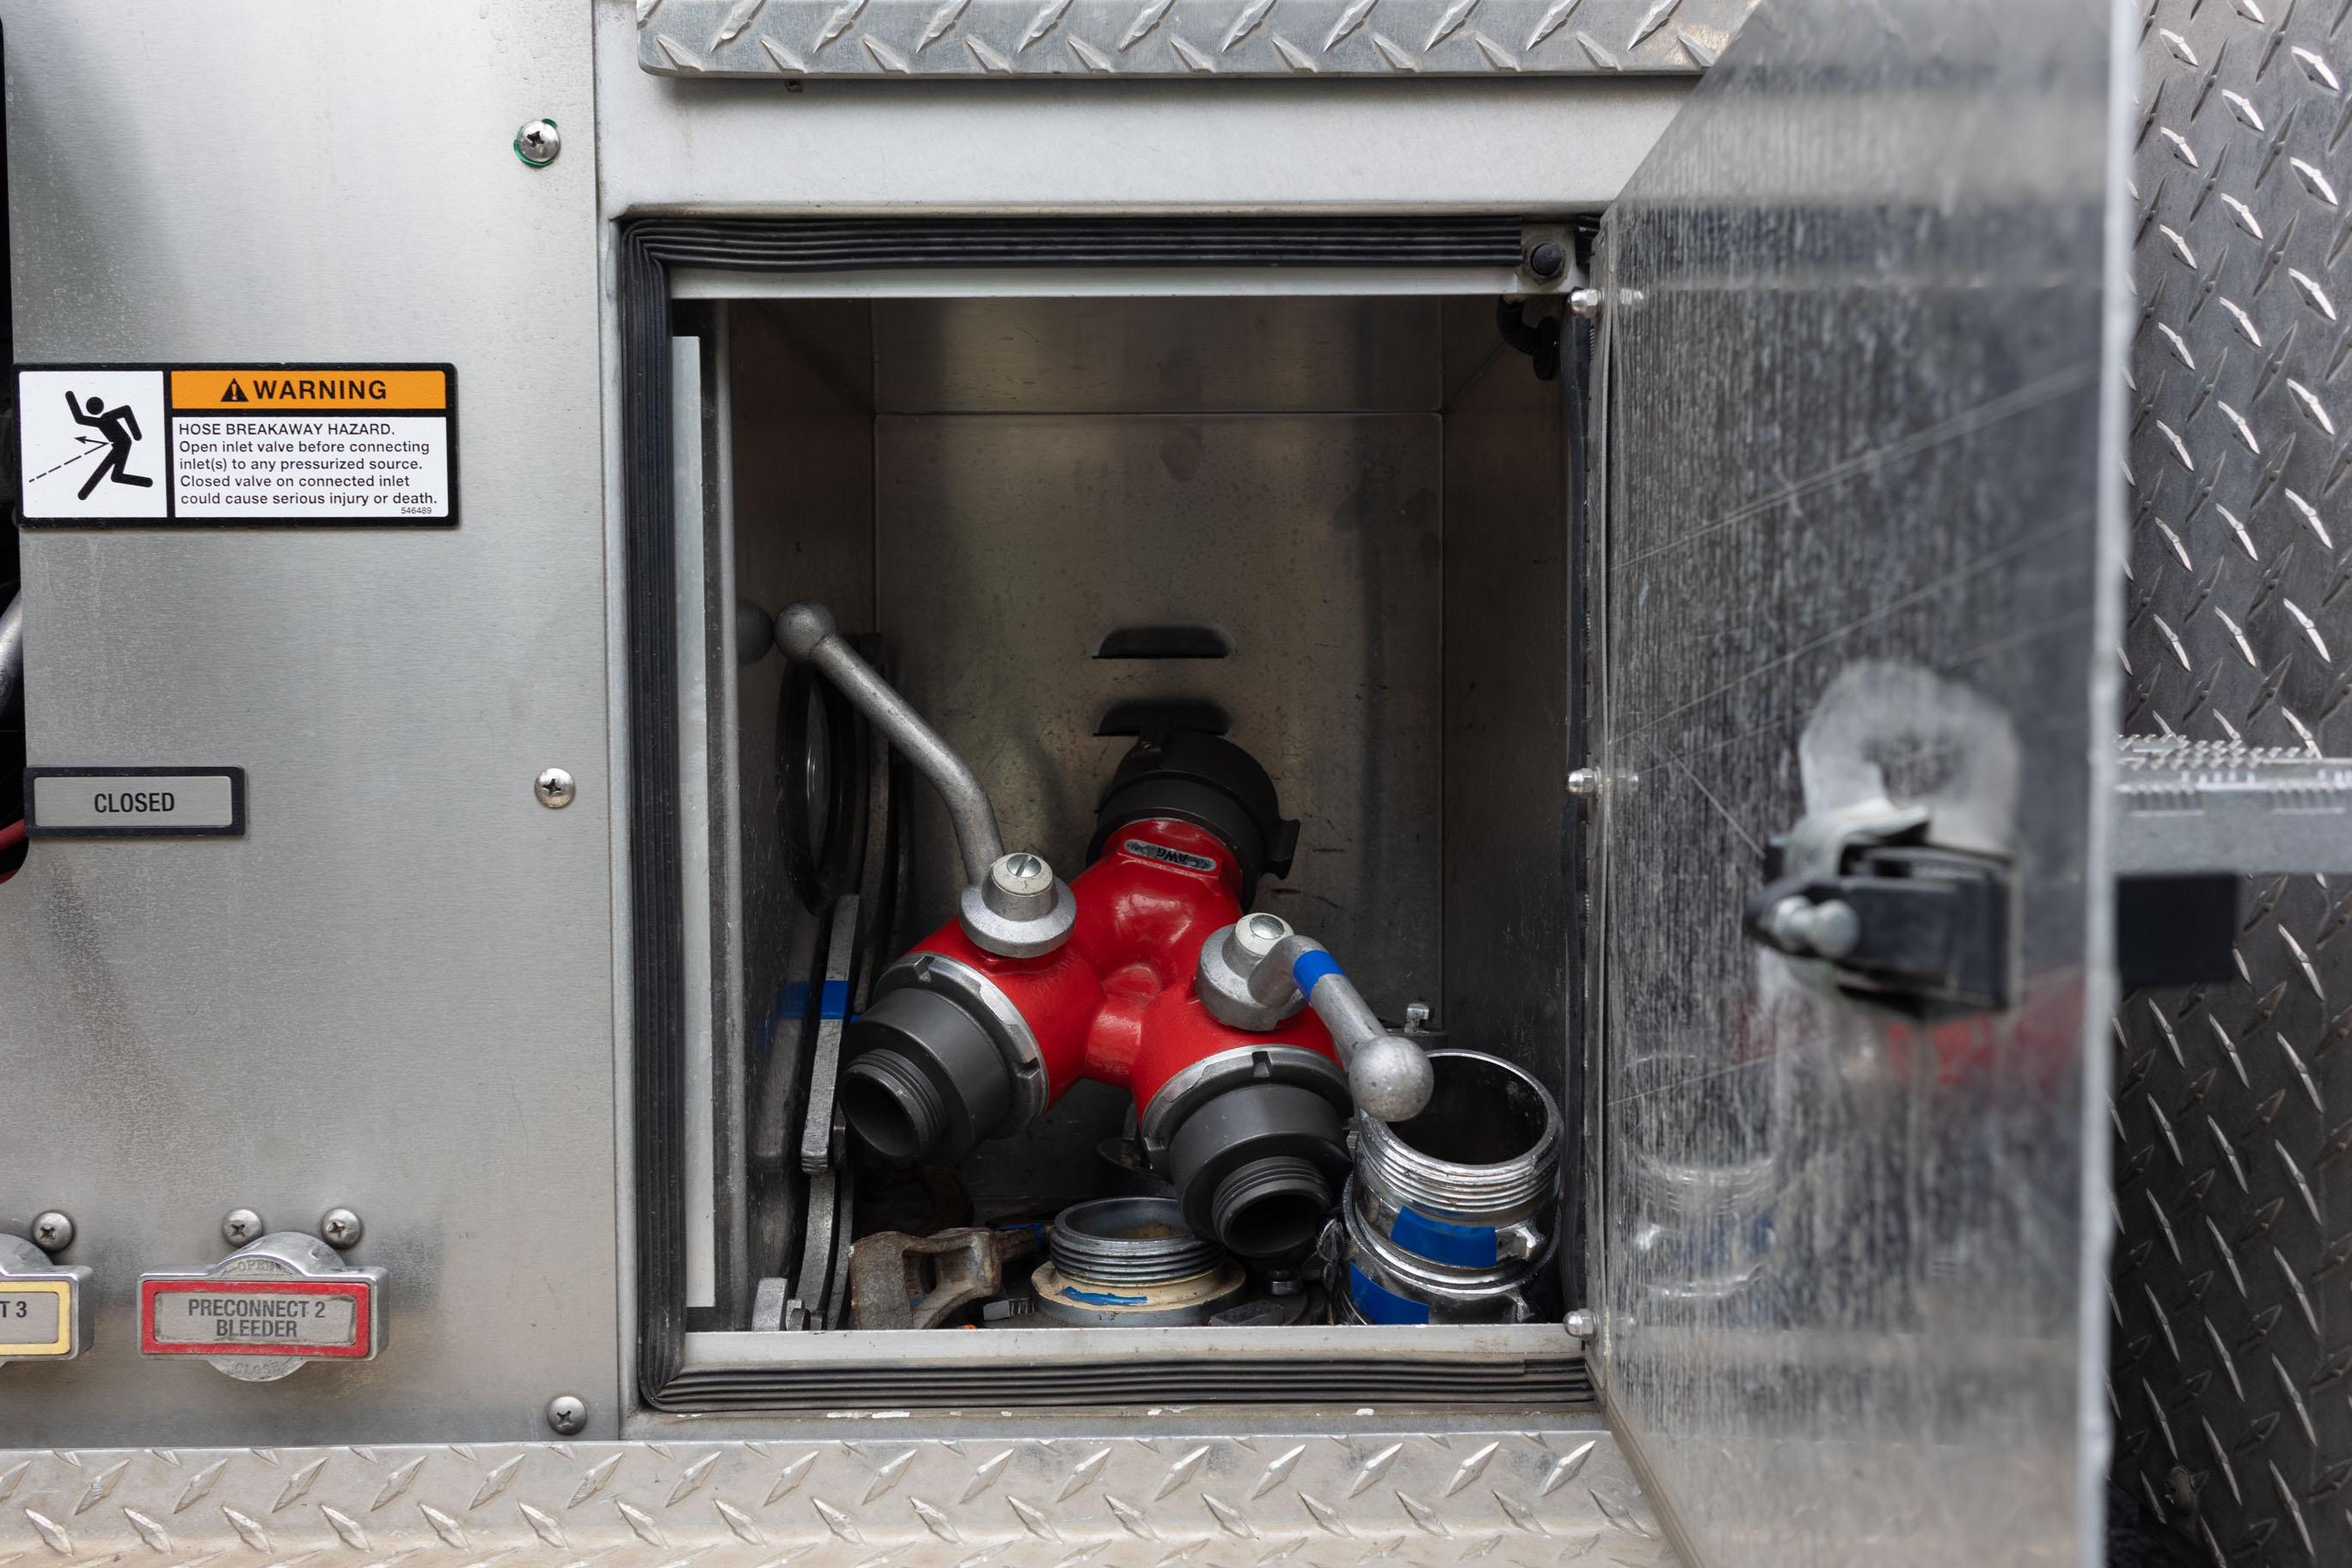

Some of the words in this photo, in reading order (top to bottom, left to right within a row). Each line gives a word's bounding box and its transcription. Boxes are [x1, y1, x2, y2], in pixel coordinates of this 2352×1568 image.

[253, 379, 387, 401] WARNING
[179, 423, 221, 436] HOSE
[226, 423, 323, 435] BREAKAWAY
[328, 423, 395, 435] HAZARD.
[179, 440, 217, 456] Open
[223, 440, 254, 453] inlet
[257, 440, 294, 452] valve
[298, 440, 345, 453] before
[349, 440, 429, 456] connecting
[180, 457, 227, 473] inlet(s)
[231, 458, 246, 470] to
[251, 461, 276, 473] any
[280, 457, 364, 473] pressurized
[369, 460, 422, 470] source.
[180, 475, 230, 487] Closed
[235, 475, 272, 487] valve
[276, 478, 294, 487] on
[298, 475, 375, 487] connected
[379, 475, 410, 487] inlet
[181, 493, 220, 505] could
[225, 495, 268, 505] cause
[273, 492, 325, 505] serious
[329, 492, 369, 507] injury
[373, 495, 389, 505] or
[392, 492, 438, 505] death.
[401, 506, 432, 515] 546489
[94, 792, 175, 813] CLOSED
[15, 1301, 28, 1319] 3
[188, 1298, 309, 1319] PRECONNECT
[315, 1301, 326, 1319] 2
[217, 1319, 297, 1338] BLEEDER
